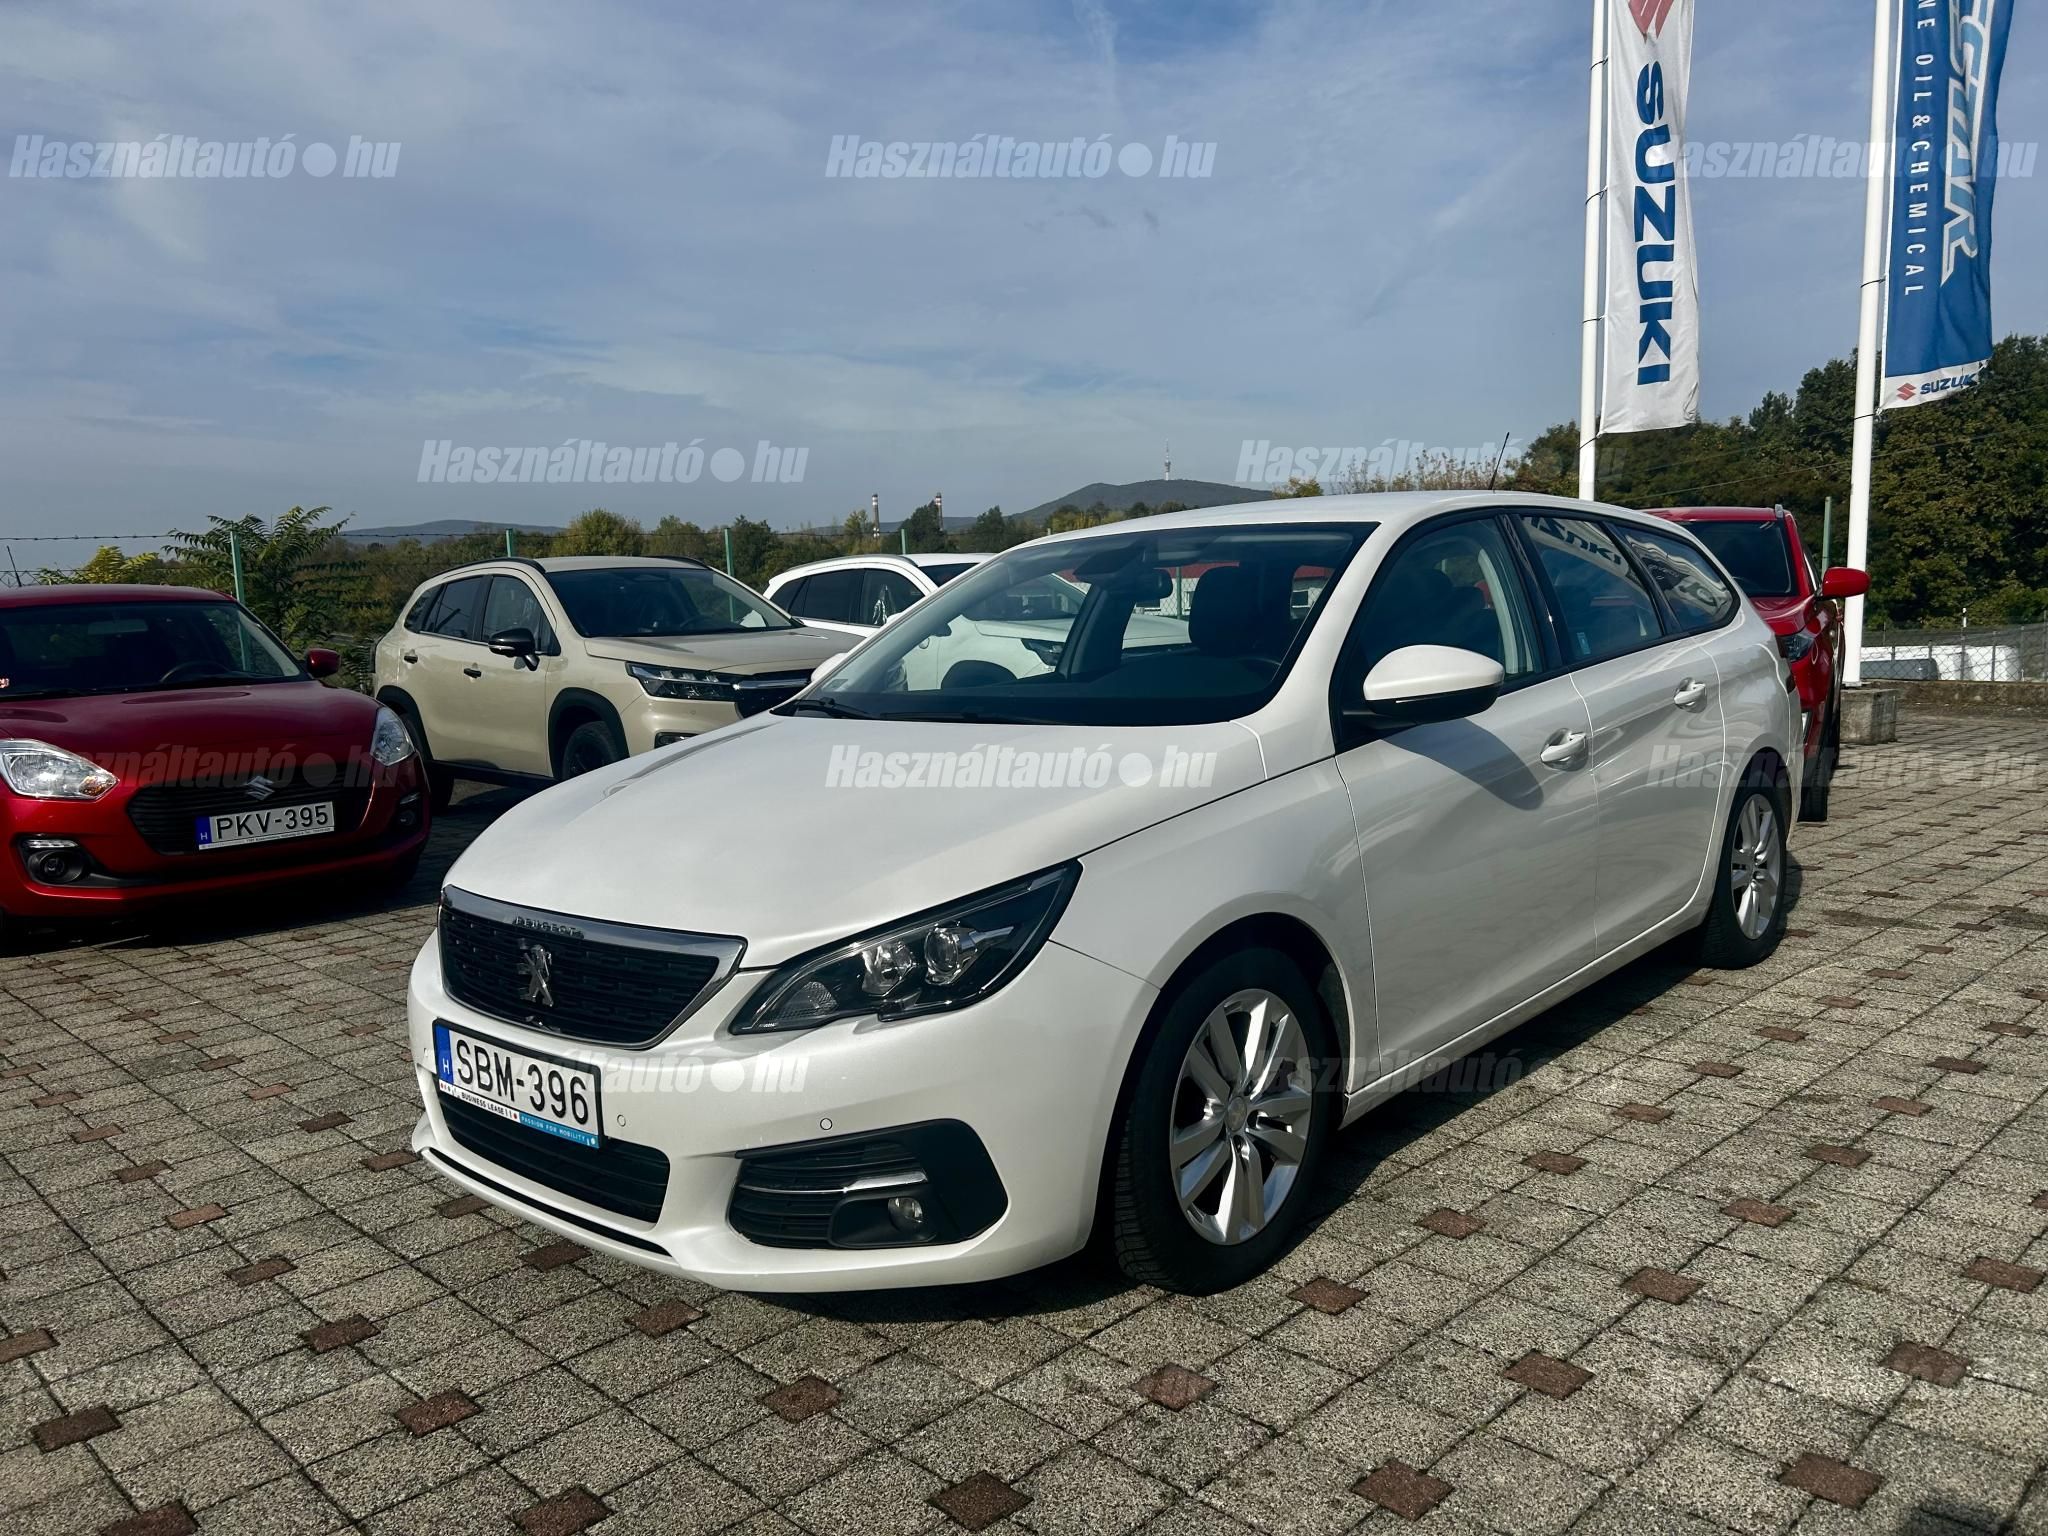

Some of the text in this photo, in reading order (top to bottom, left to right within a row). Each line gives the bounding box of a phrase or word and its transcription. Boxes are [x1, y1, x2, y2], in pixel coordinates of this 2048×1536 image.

[1634, 60, 1677, 386] SUZUKI
[1920, 373, 1979, 395] SUZUK
[216, 804, 329, 840] PKV-395
[442, 1058, 450, 1075] H
[456, 1039, 589, 1125] SBM-396
[461, 1092, 504, 1115] BUSINESS LEASE
